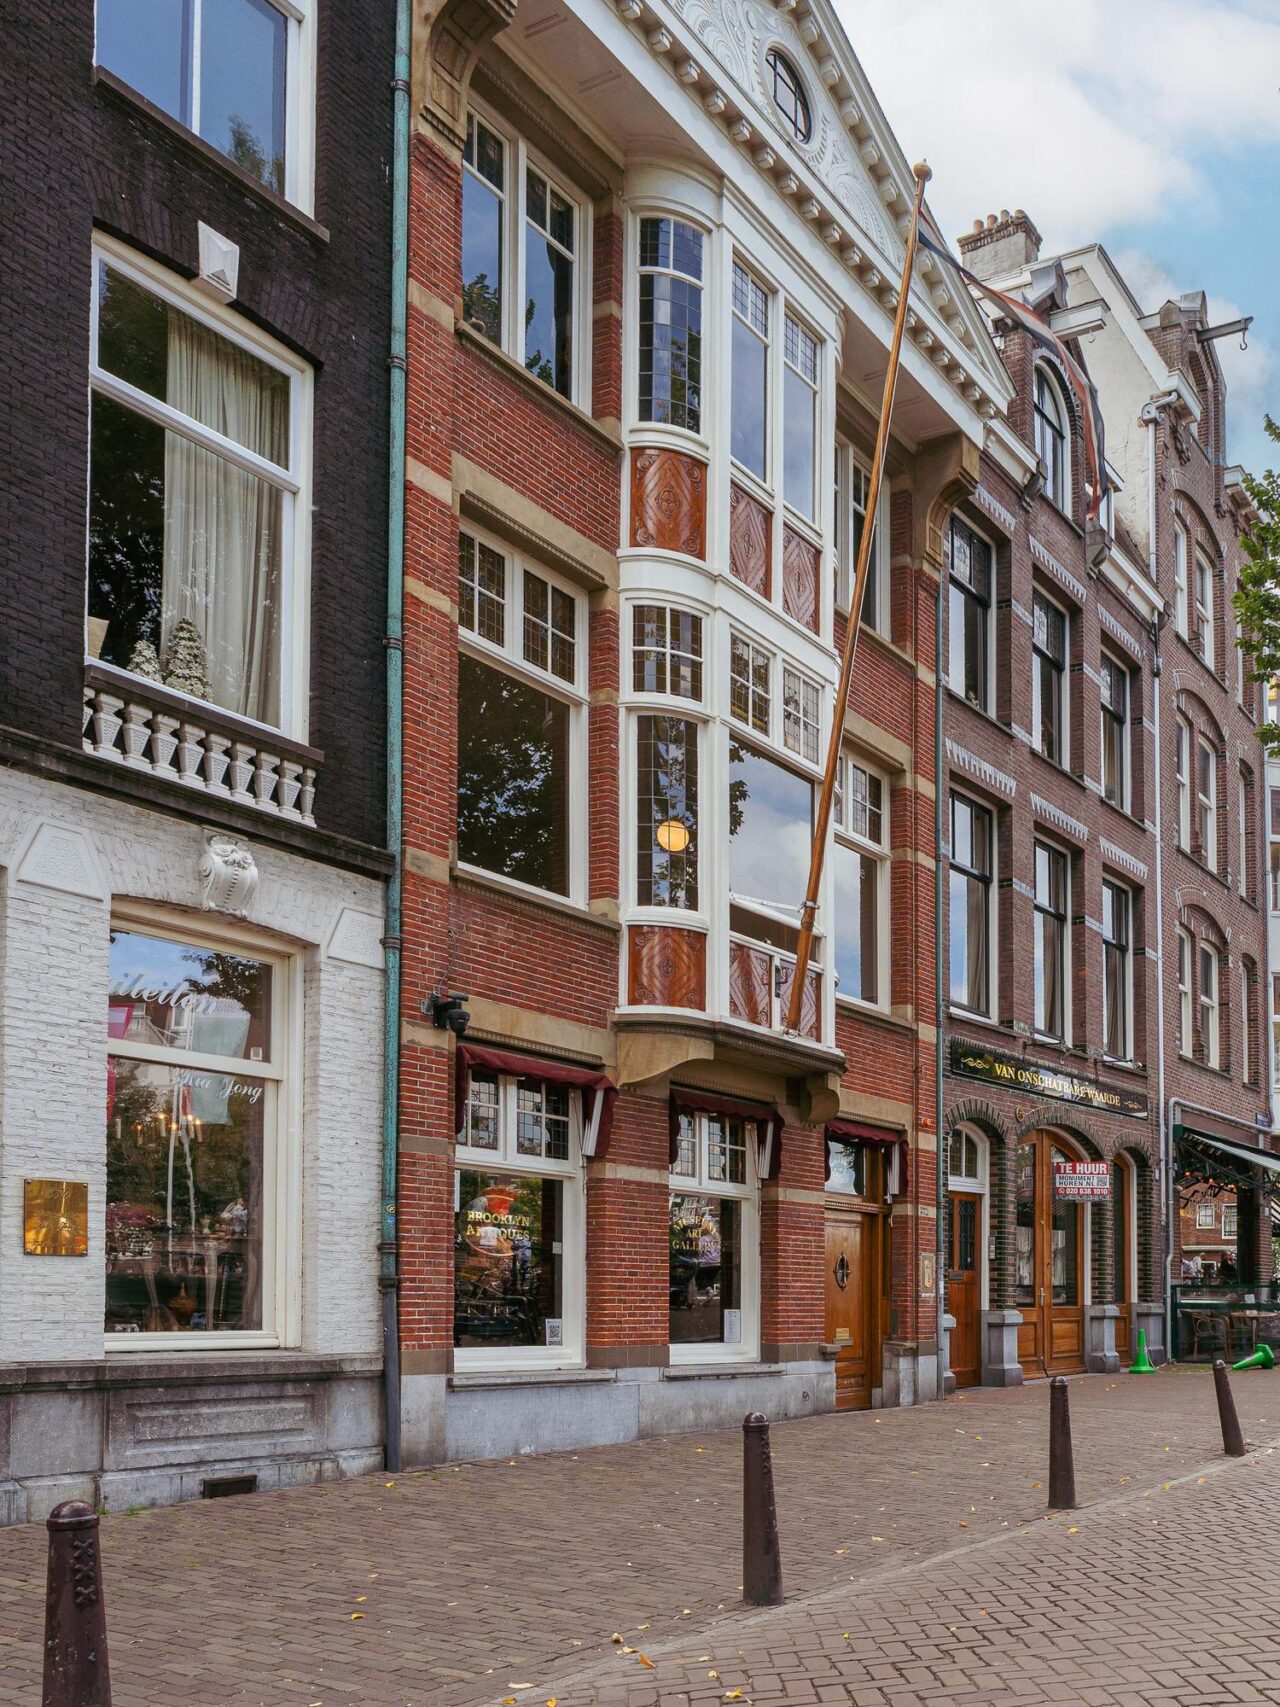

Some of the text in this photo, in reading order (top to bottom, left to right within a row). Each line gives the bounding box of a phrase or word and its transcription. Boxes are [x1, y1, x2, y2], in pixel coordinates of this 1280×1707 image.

[219, 1075, 263, 1103] Jong
[994, 1062, 1121, 1107] VAN ONSCHATBARE WAARDE
[1058, 1163, 1107, 1174] TE HUUR
[467, 1210, 530, 1227] BROOKLYN
[687, 1228, 704, 1238] ART
